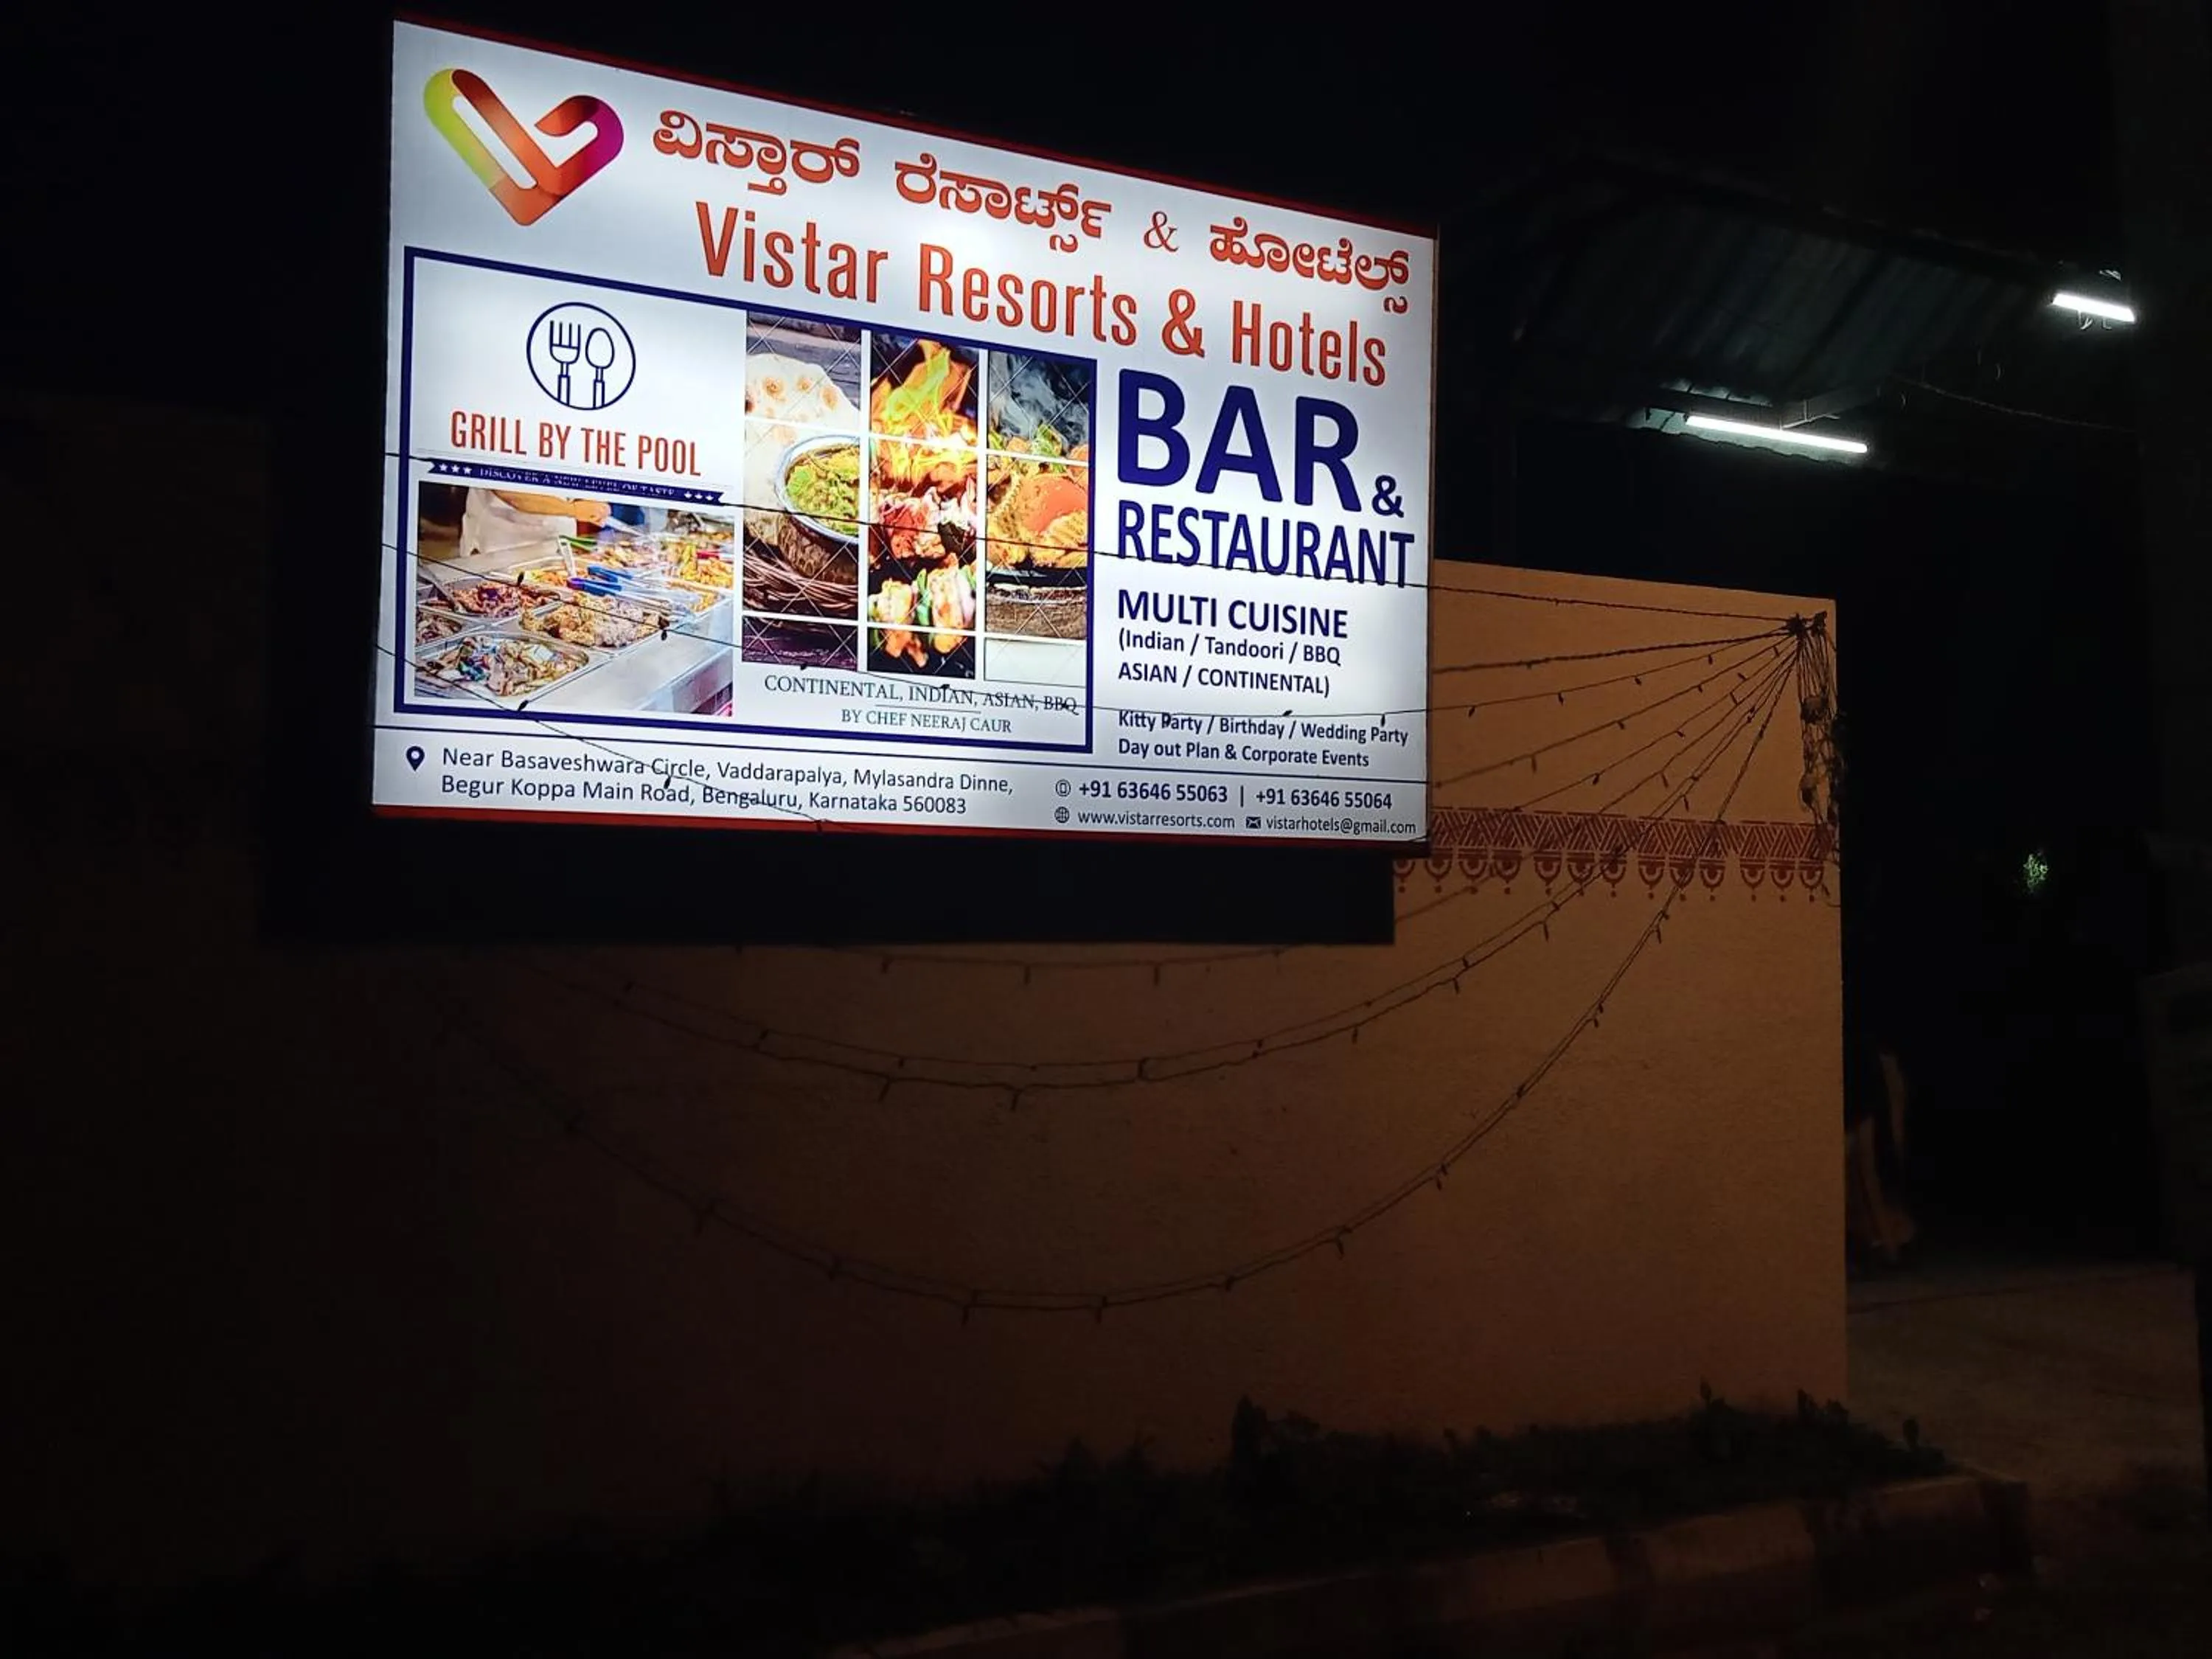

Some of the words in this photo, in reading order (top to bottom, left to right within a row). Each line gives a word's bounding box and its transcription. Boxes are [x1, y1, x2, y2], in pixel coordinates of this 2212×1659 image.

[653, 110, 860, 195] ವಿಸ್ತಾರ್
[1144, 211, 1178, 251] &
[1209, 217, 1409, 314] ಹೋಟೆಲ್ಸ್
[696, 201, 888, 302] Vistar
[919, 243, 1137, 347] Resorts
[1161, 289, 1205, 358] &
[1232, 301, 1386, 386] Hotels
[451, 411, 527, 456] GRILL
[538, 422, 571, 460] BY
[581, 428, 626, 467] THE
[639, 435, 701, 477] POOL
[1118, 369, 1361, 512] BAR
[1372, 475, 1405, 517] &
[1119, 500, 1414, 587] RESTAURANT
[1118, 589, 1217, 627] MULTI
[1228, 599, 1349, 639] CUISINE
[1119, 627, 1184, 651] (Indian
[1189, 633, 1200, 655] /
[1205, 636, 1284, 659] Tandoori
[1289, 641, 1298, 664] /
[1304, 645, 1340, 666] BBQ
[764, 675, 904, 702] CONTINENTAL,
[909, 684, 978, 707] INDIAN,
[983, 691, 1038, 712] ASIAN,
[1043, 695, 1079, 716] BBQ
[1119, 662, 1177, 684] ASIAN
[1183, 665, 1192, 687] /
[1198, 668, 1329, 698] CONTINENTAL)
[841, 709, 862, 723] BY
[866, 711, 906, 727] CHEF
[910, 713, 966, 732] NEERAJ
[970, 717, 1012, 733] CAUR
[1119, 710, 1156, 731] Kitty
[1161, 713, 1203, 734] Party
[1207, 715, 1214, 734] /
[1220, 718, 1284, 739] Birthday
[1289, 721, 1296, 739] /
[1301, 723, 1366, 744] Wedding
[1371, 726, 1408, 746] Party
[442, 747, 495, 768] Near
[501, 750, 644, 774] Basaveshwara
[651, 758, 711, 780] Circle,
[717, 762, 847, 787] Vaddarapalya,
[853, 768, 954, 791] Mylasandra
[961, 775, 1013, 794] Dinne,
[1119, 739, 1149, 759] Day
[1155, 742, 1180, 757] out
[1186, 742, 1220, 759] Plan
[1225, 744, 1237, 760] &
[1242, 745, 1318, 766] Corporate
[1323, 751, 1369, 767] Events
[442, 775, 504, 799] Begur
[510, 778, 575, 801] Koppa
[582, 782, 633, 801] Main
[641, 783, 695, 806] Road,
[703, 786, 803, 810] Bengaluru,
[809, 793, 897, 811] Karnataka
[903, 795, 967, 814] 560083
[1079, 781, 1111, 798] +91
[1117, 782, 1171, 800] 63646
[1176, 785, 1228, 802] 55063
[1256, 788, 1285, 805] +91
[1291, 789, 1340, 807] 63646
[1345, 791, 1392, 809] 55064
[1078, 810, 1234, 829] www.vistarresorts.com
[1267, 816, 1416, 835] vistarhotels@gmail.com
